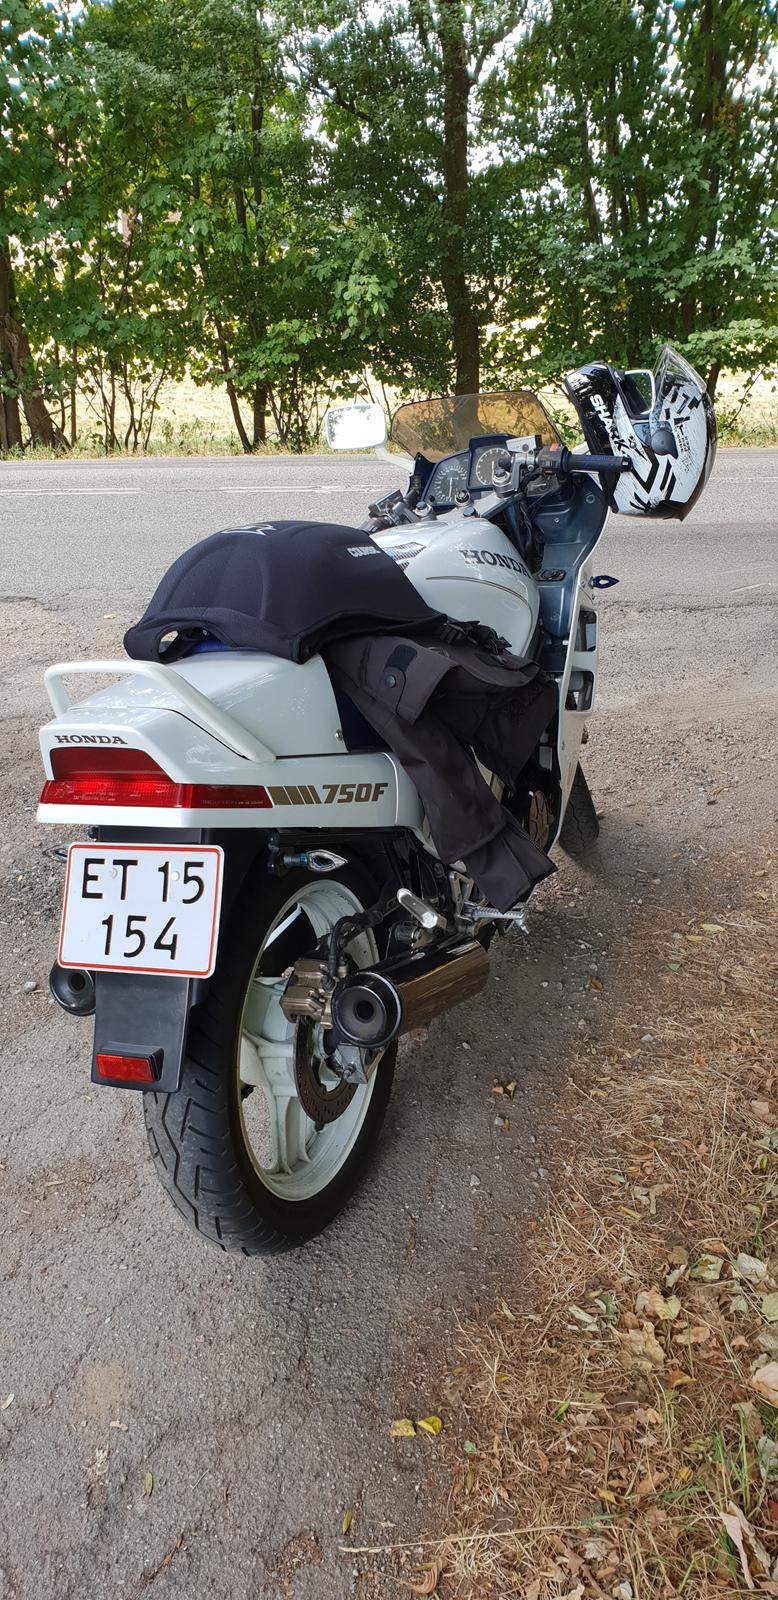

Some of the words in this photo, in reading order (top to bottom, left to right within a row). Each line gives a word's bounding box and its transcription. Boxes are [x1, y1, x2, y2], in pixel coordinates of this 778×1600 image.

[589, 393, 629, 452] SHARK
[459, 549, 533, 579] HONDA
[55, 734, 127, 745] HONDA
[322, 782, 388, 804] 750F
[81, 858, 138, 901] ET
[157, 861, 205, 904] 15
[101, 915, 179, 961] 154
